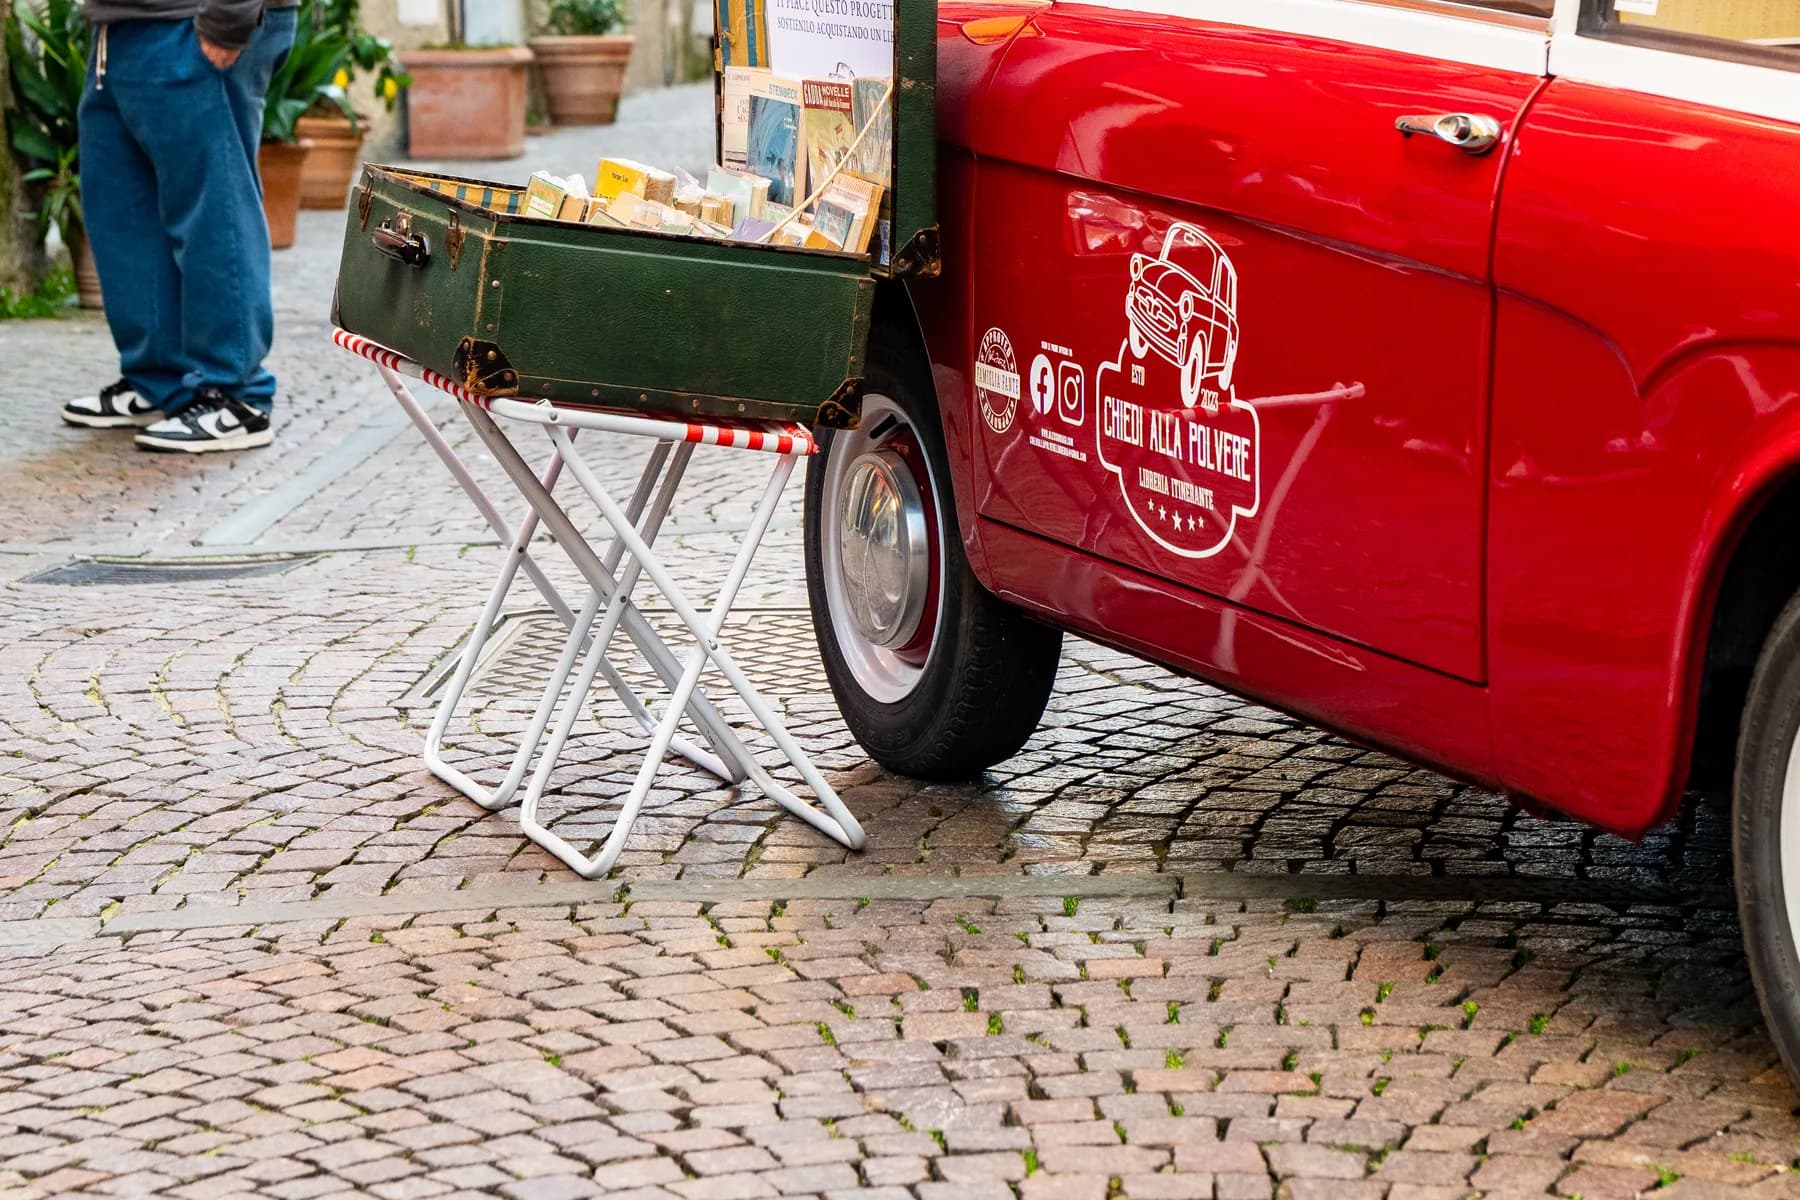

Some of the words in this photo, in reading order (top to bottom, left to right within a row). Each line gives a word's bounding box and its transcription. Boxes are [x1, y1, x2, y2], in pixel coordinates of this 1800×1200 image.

[777, 16, 815, 33] SOSTIENILO
[816, 22, 869, 41] ACQUISTANDO
[870, 28, 882, 41] UN
[822, 85, 850, 98] NOVELLE
[983, 331, 1011, 358] APPROVED
[976, 366, 1001, 388] FAMIGLIA
[1200, 388, 1219, 413] 2023
[1104, 395, 1144, 448] CHIEDI
[1149, 409, 1183, 461] ALLA
[1188, 421, 1251, 482] POLVERE
[1138, 467, 1170, 496] LIBRERIA
[1171, 477, 1214, 511] ITINERANTE
